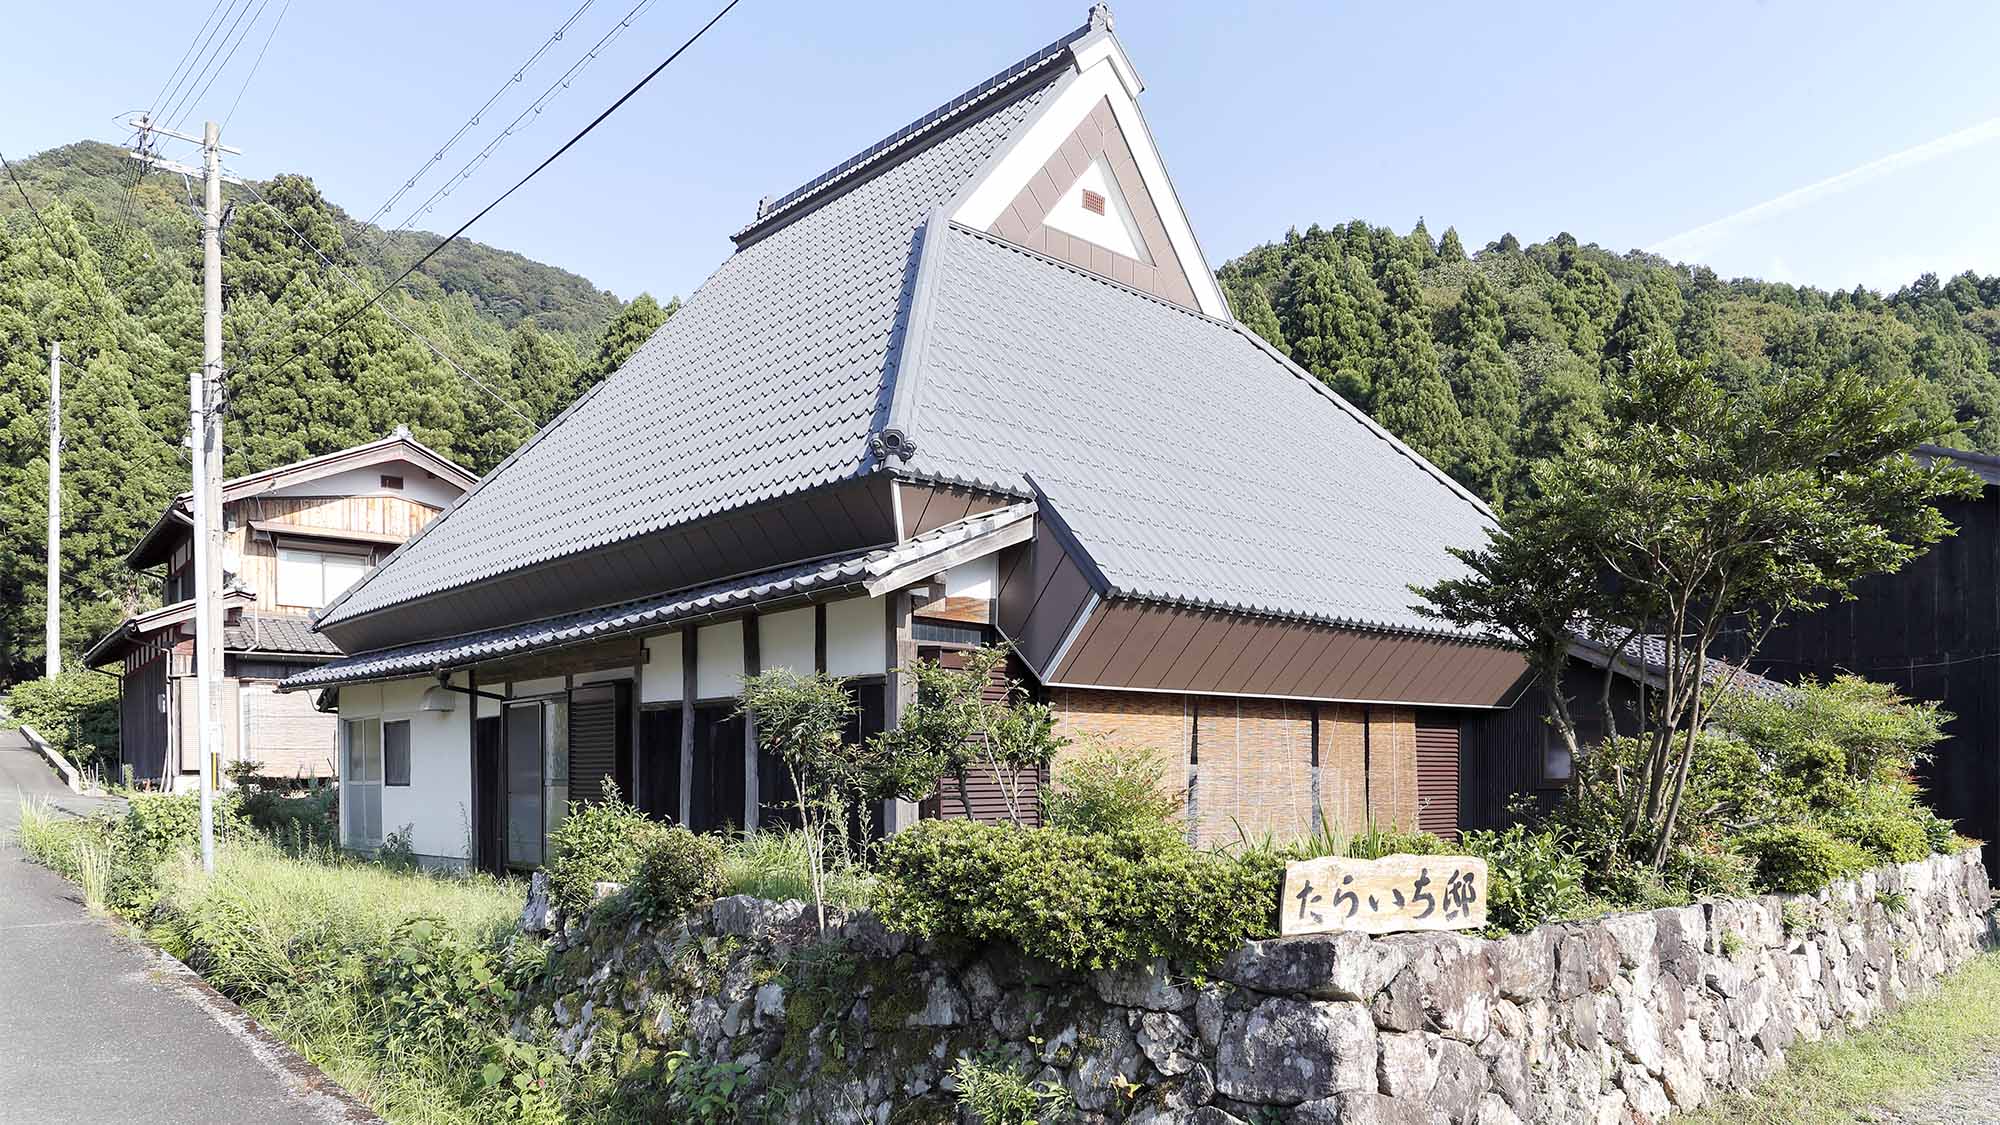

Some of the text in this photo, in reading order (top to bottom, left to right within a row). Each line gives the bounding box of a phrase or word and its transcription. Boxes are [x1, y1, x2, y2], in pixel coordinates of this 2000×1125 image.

[1296, 868, 1476, 923] たらいち邸
